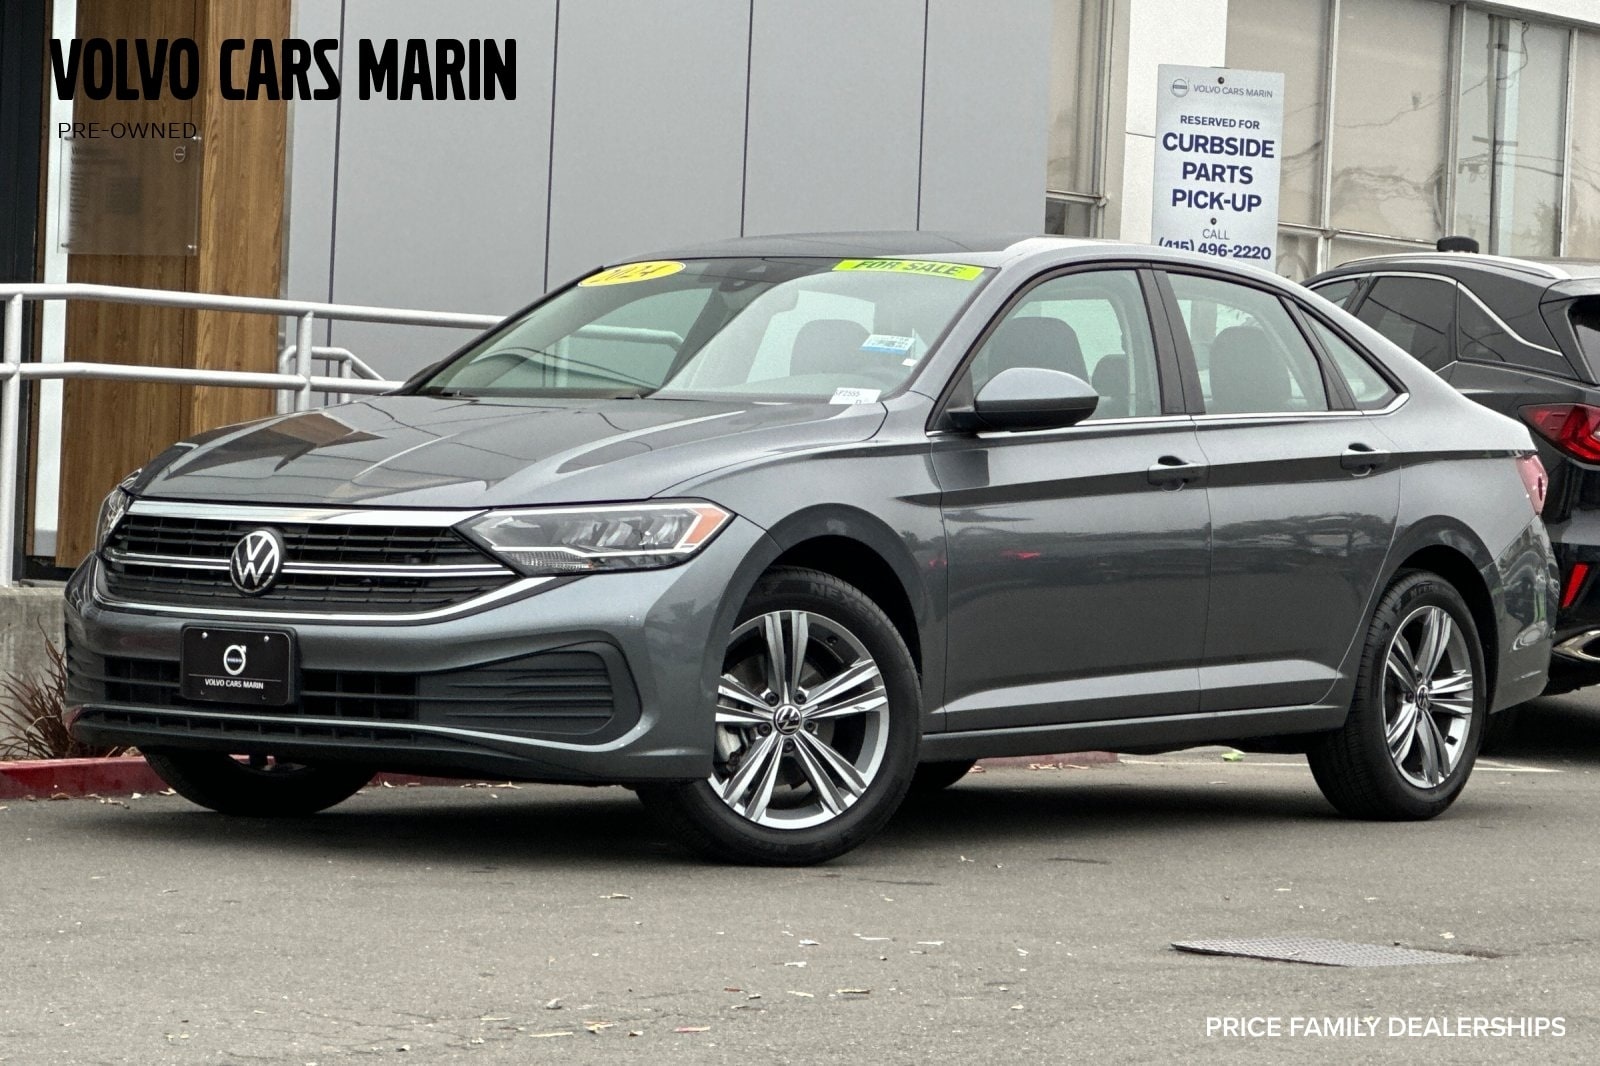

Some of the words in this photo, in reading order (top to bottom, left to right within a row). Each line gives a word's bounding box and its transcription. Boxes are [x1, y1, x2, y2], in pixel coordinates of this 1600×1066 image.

[1193, 84, 1221, 94] VOLVO
[1222, 86, 1245, 96] CARS
[1246, 88, 1273, 98] MARIN
[1180, 115, 1236, 128] RESERVED
[1238, 119, 1260, 130] FOR
[1162, 132, 1275, 158] CURBSIDE
[1182, 161, 1254, 185] PARTS
[1171, 188, 1262, 212] PICK-UP
[1202, 228, 1230, 240] CALL
[1198, 242, 1272, 260] 496-2220
[853, 260, 899, 270] FOR
[903, 261, 963, 275] SALE
[204, 678, 225, 687] VOLVO
[225, 679, 242, 688] CARS
[242, 680, 264, 690] MARIN
